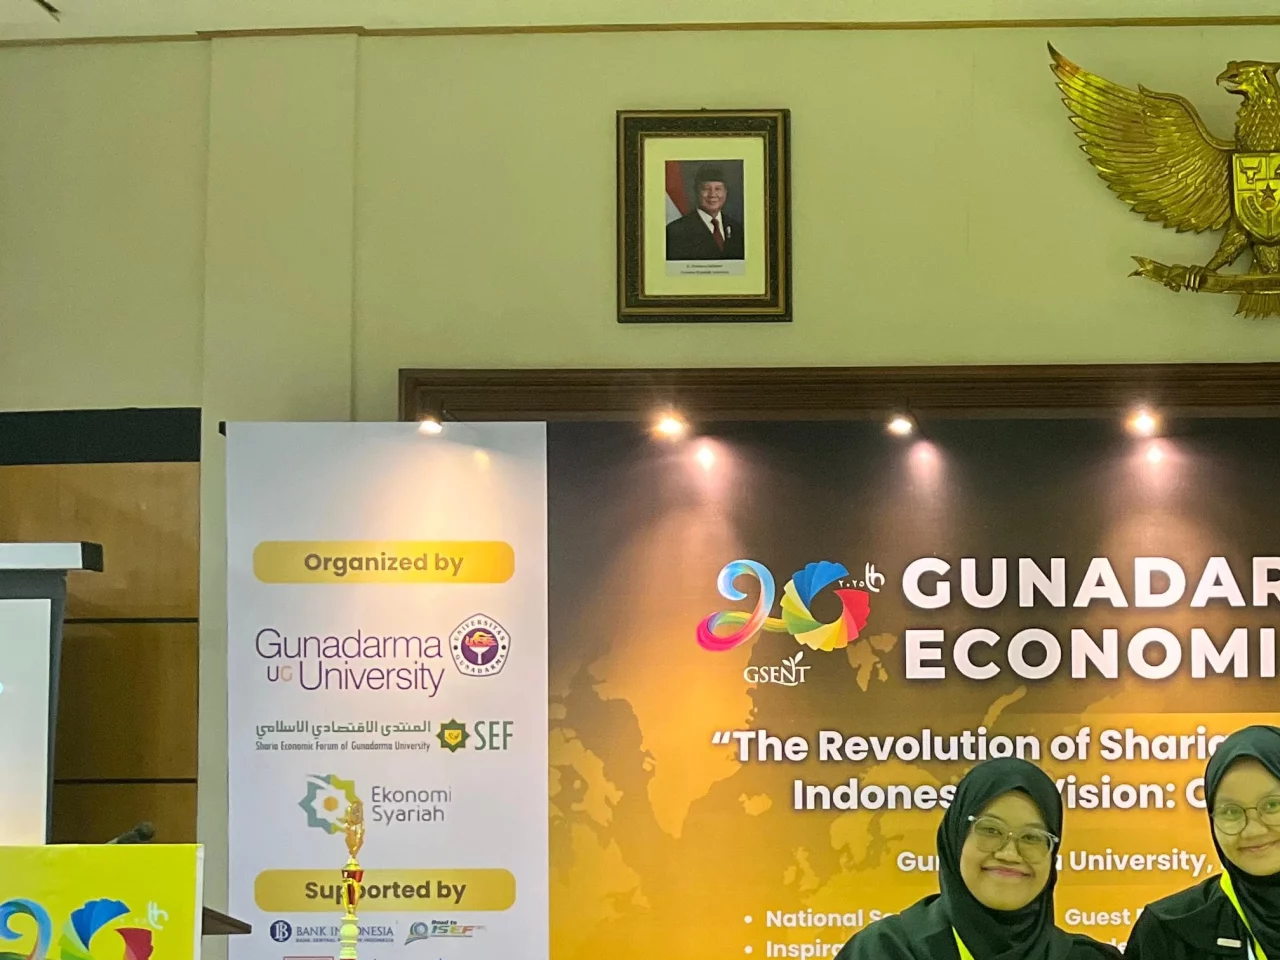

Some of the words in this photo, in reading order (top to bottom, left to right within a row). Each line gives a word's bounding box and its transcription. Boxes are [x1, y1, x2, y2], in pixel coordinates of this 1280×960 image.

[304, 552, 427, 577] Organized
[435, 553, 464, 577] by
[256, 628, 443, 658] Gunadarma
[300, 661, 445, 697] University
[743, 658, 811, 686] GSENT
[395, 740, 431, 752] University
[474, 720, 514, 751] SEF
[712, 730, 808, 762] “The
[819, 729, 1040, 761] Revolution
[1050, 727, 1091, 761] of
[372, 786, 452, 803] Ekonomi
[794, 778, 957, 810] Indones
[371, 805, 445, 826] Syariah
[1070, 848, 1214, 877] University,
[437, 880, 467, 904] by
[431, 925, 475, 934] ISEF
[766, 908, 863, 927] National
[1064, 908, 1131, 926] Guest
[296, 926, 328, 937] BANK
